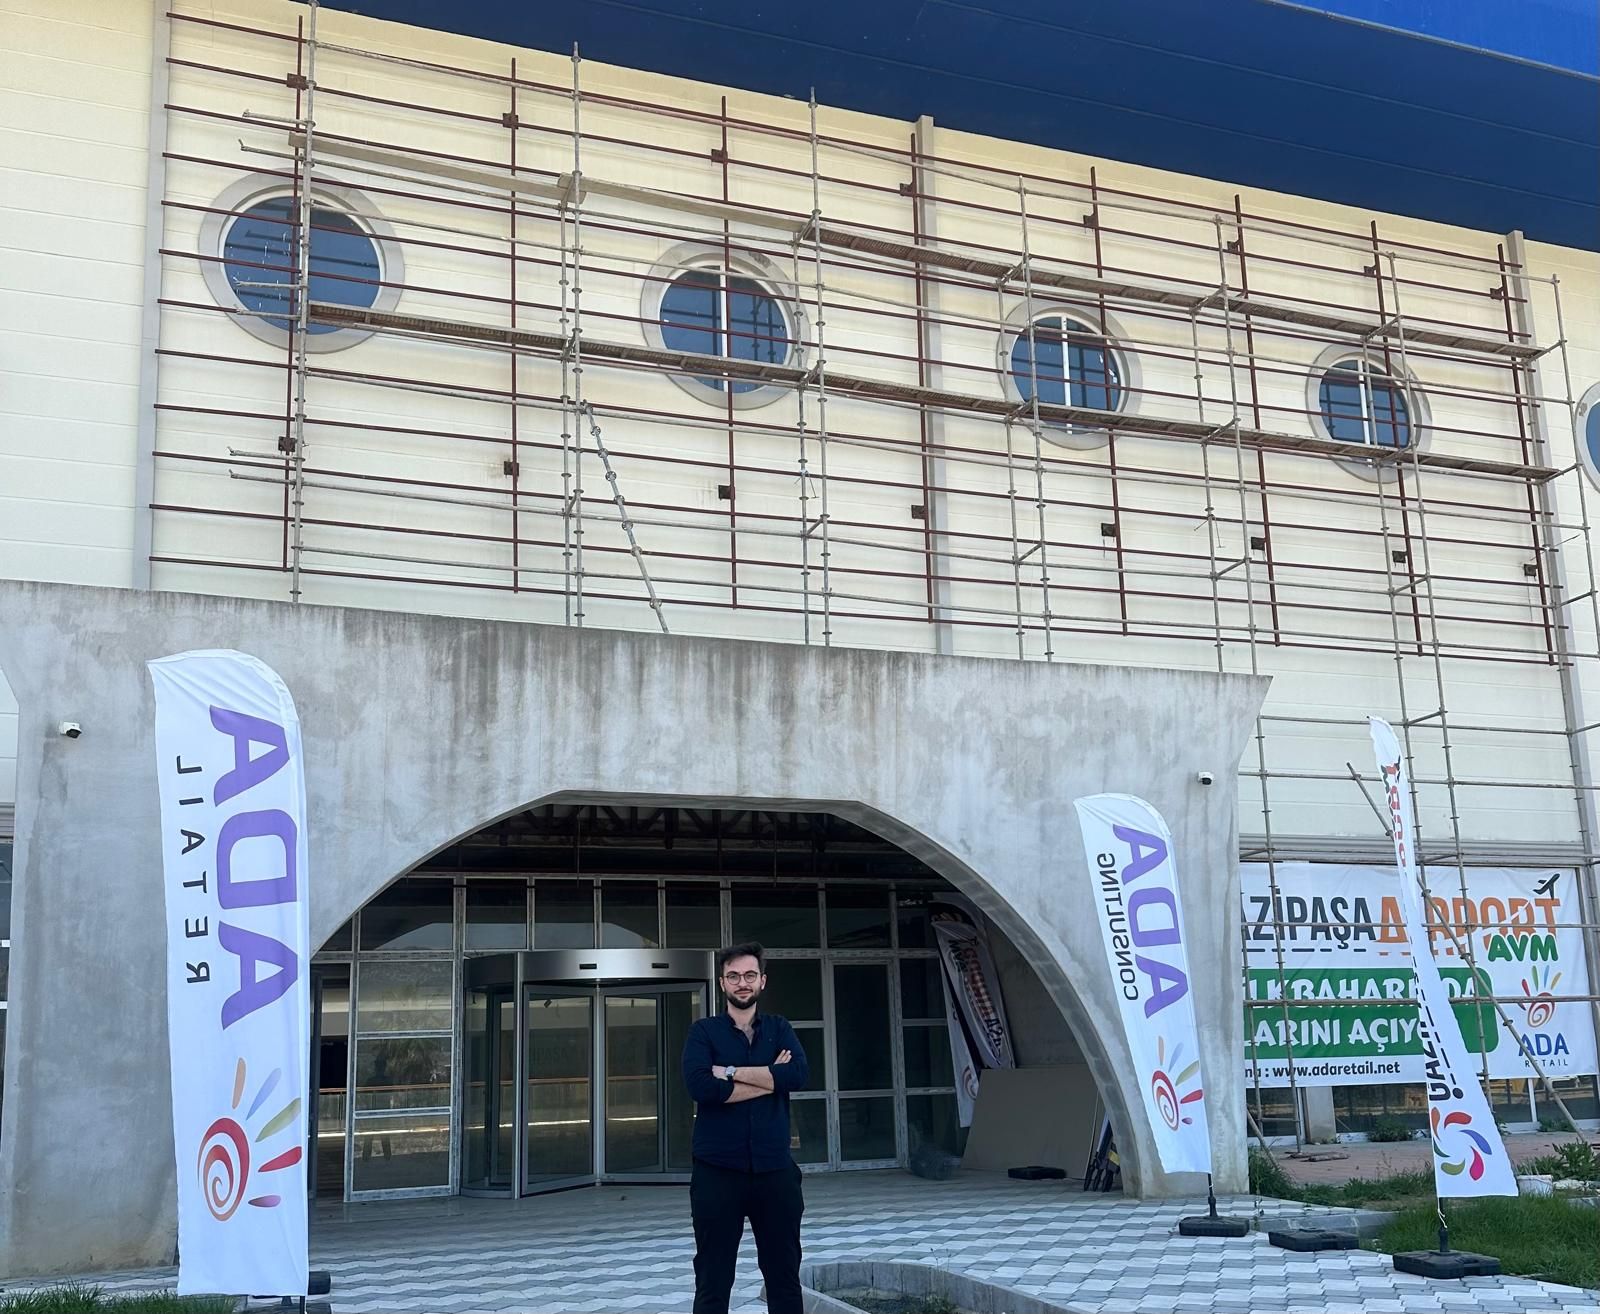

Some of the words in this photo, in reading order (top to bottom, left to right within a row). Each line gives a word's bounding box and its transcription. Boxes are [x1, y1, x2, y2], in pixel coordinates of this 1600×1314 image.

[1376, 895, 1561, 954] ARPORT
[1487, 932, 1560, 963] AVM
[1347, 1017, 1424, 1052] AÇIY
[1518, 1032, 1570, 1057] ADA
[1272, 1060, 1401, 1078] www.adaretail.net
[1524, 1058, 1569, 1068] RTAIL
